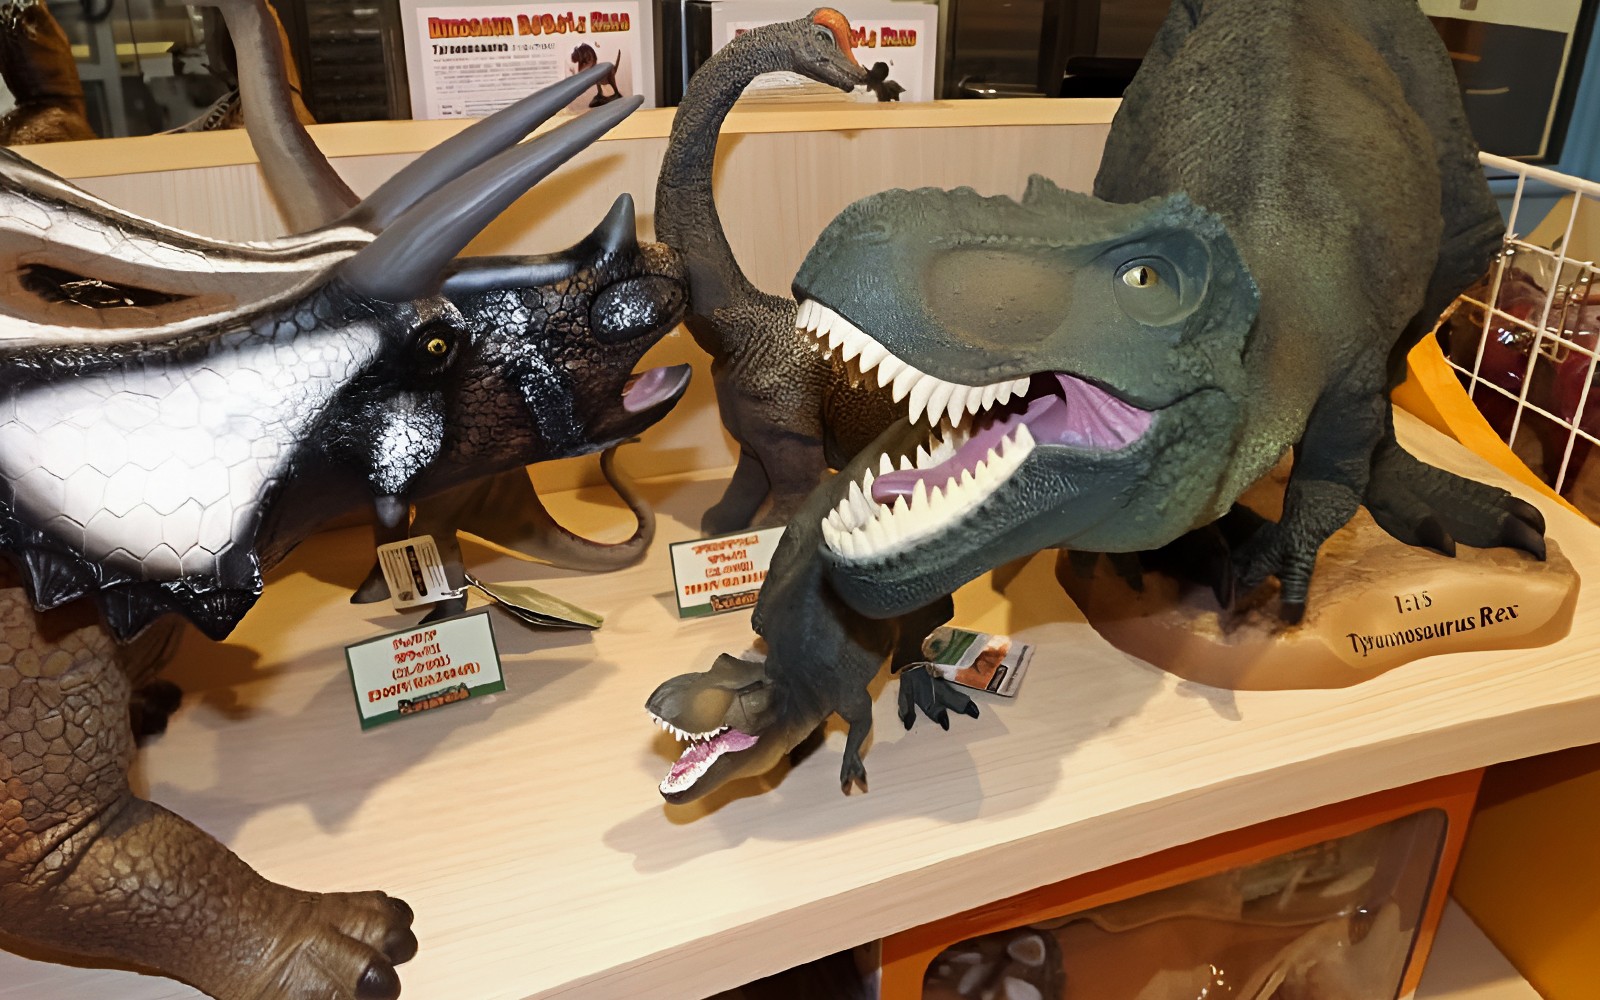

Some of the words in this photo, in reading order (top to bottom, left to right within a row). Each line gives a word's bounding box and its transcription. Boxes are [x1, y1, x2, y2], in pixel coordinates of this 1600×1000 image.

[1394, 591, 1432, 614] 1:15
[1346, 616, 1476, 657] Tyrannosaurus
[1480, 604, 1519, 628] Rex
